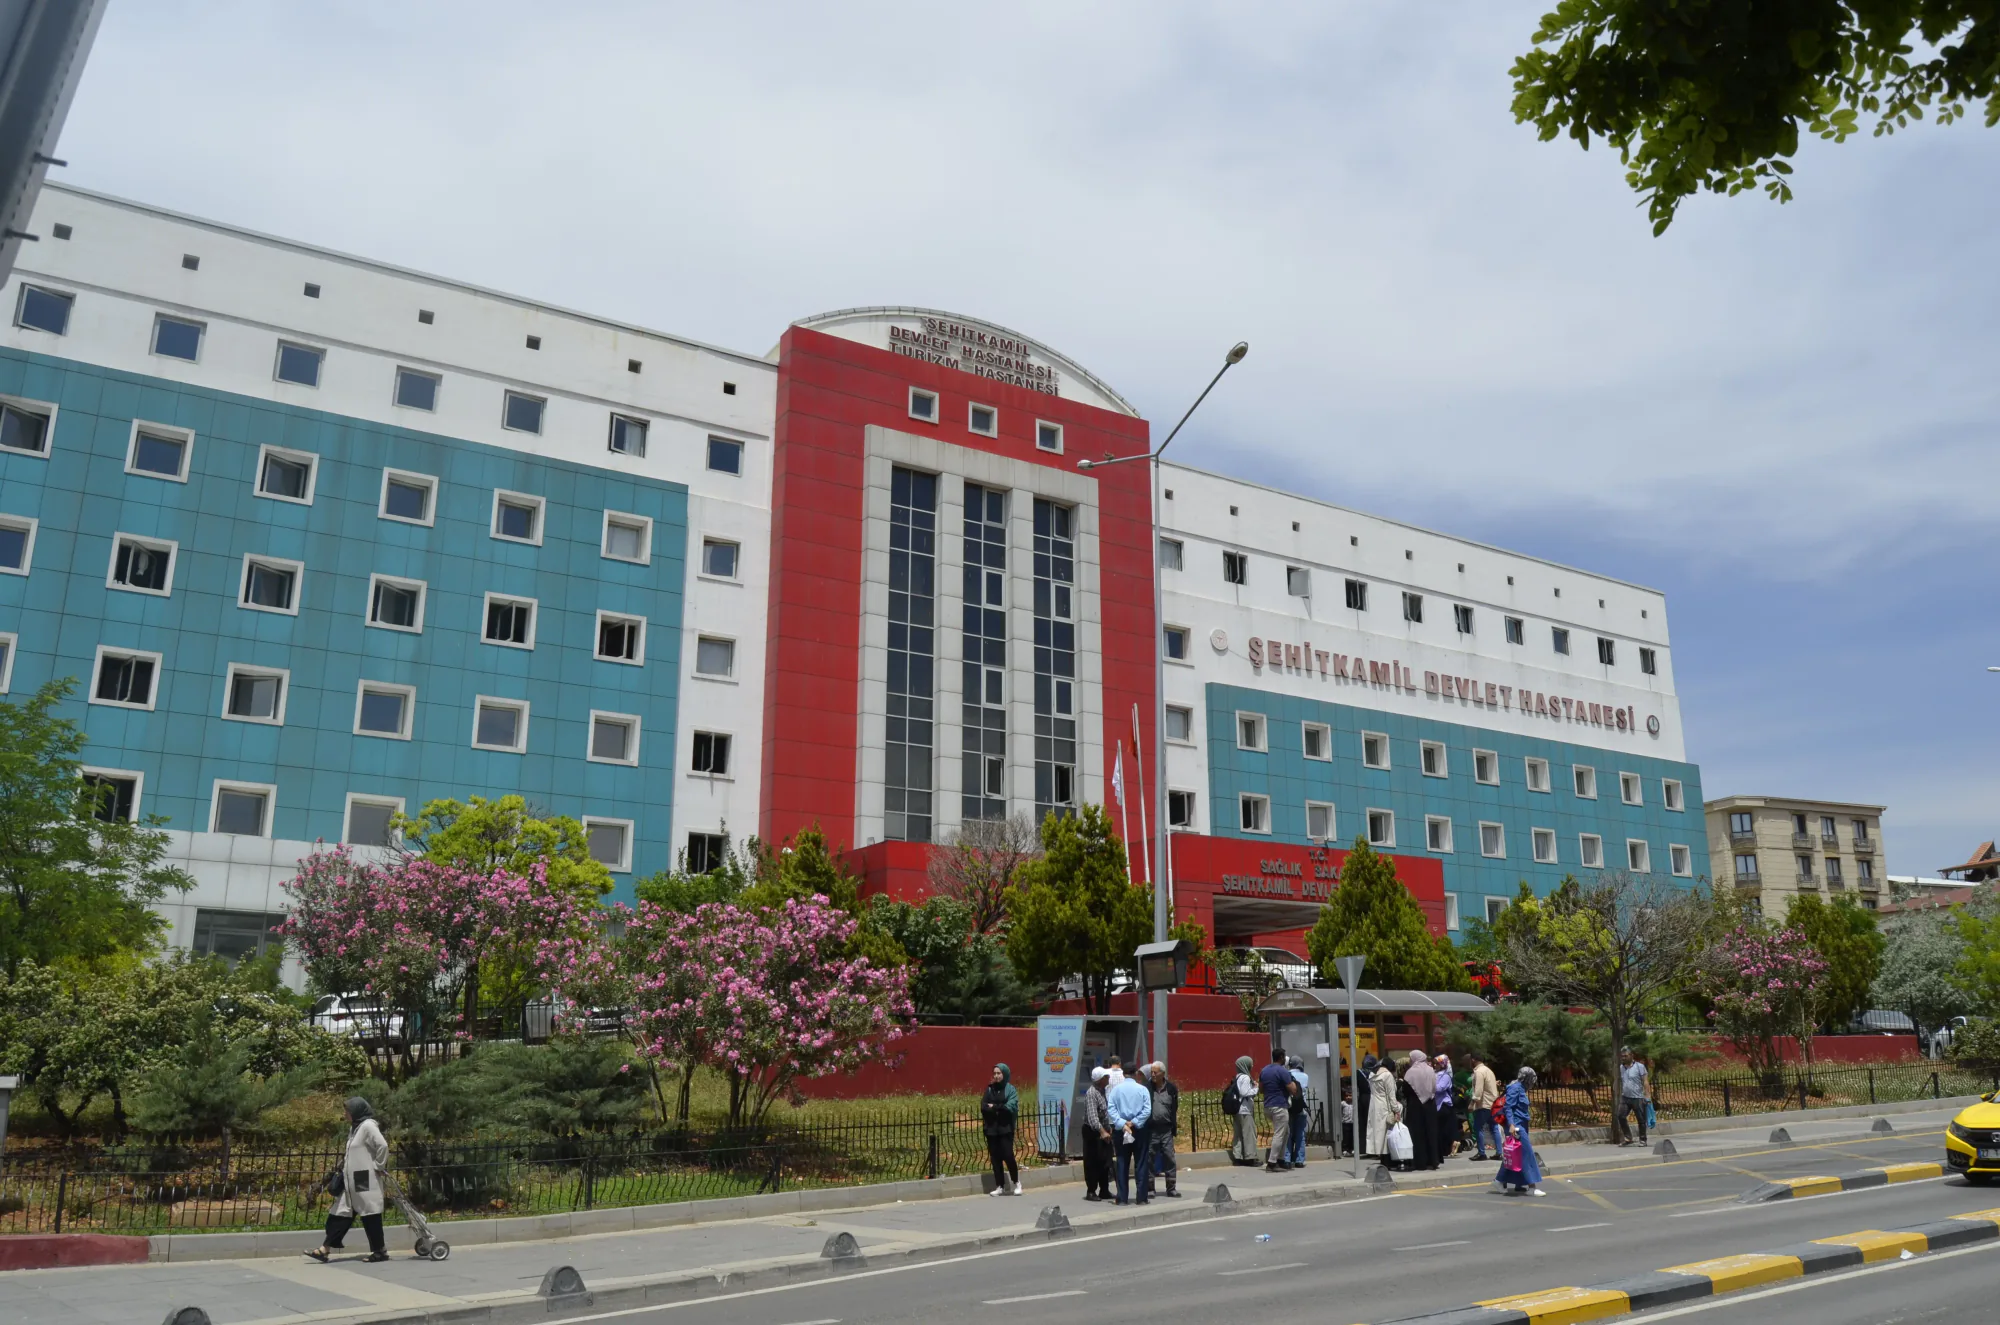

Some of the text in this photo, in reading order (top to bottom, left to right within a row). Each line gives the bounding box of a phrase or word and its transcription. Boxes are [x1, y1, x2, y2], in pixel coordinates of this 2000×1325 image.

[890, 325, 1052, 380] DEVLET HASTANESİ
[926, 317, 1031, 357] ŞEHİTKAMİL
[889, 341, 1059, 397] TURİZM HASTANESİ
[1248, 636, 1636, 731] ŞEHİTKAMİL DEVLET HASTANESİ
[1222, 871, 1341, 898] ŞEHİTKAMİL DEVLE
[1260, 857, 1303, 876] SAĞLIK
